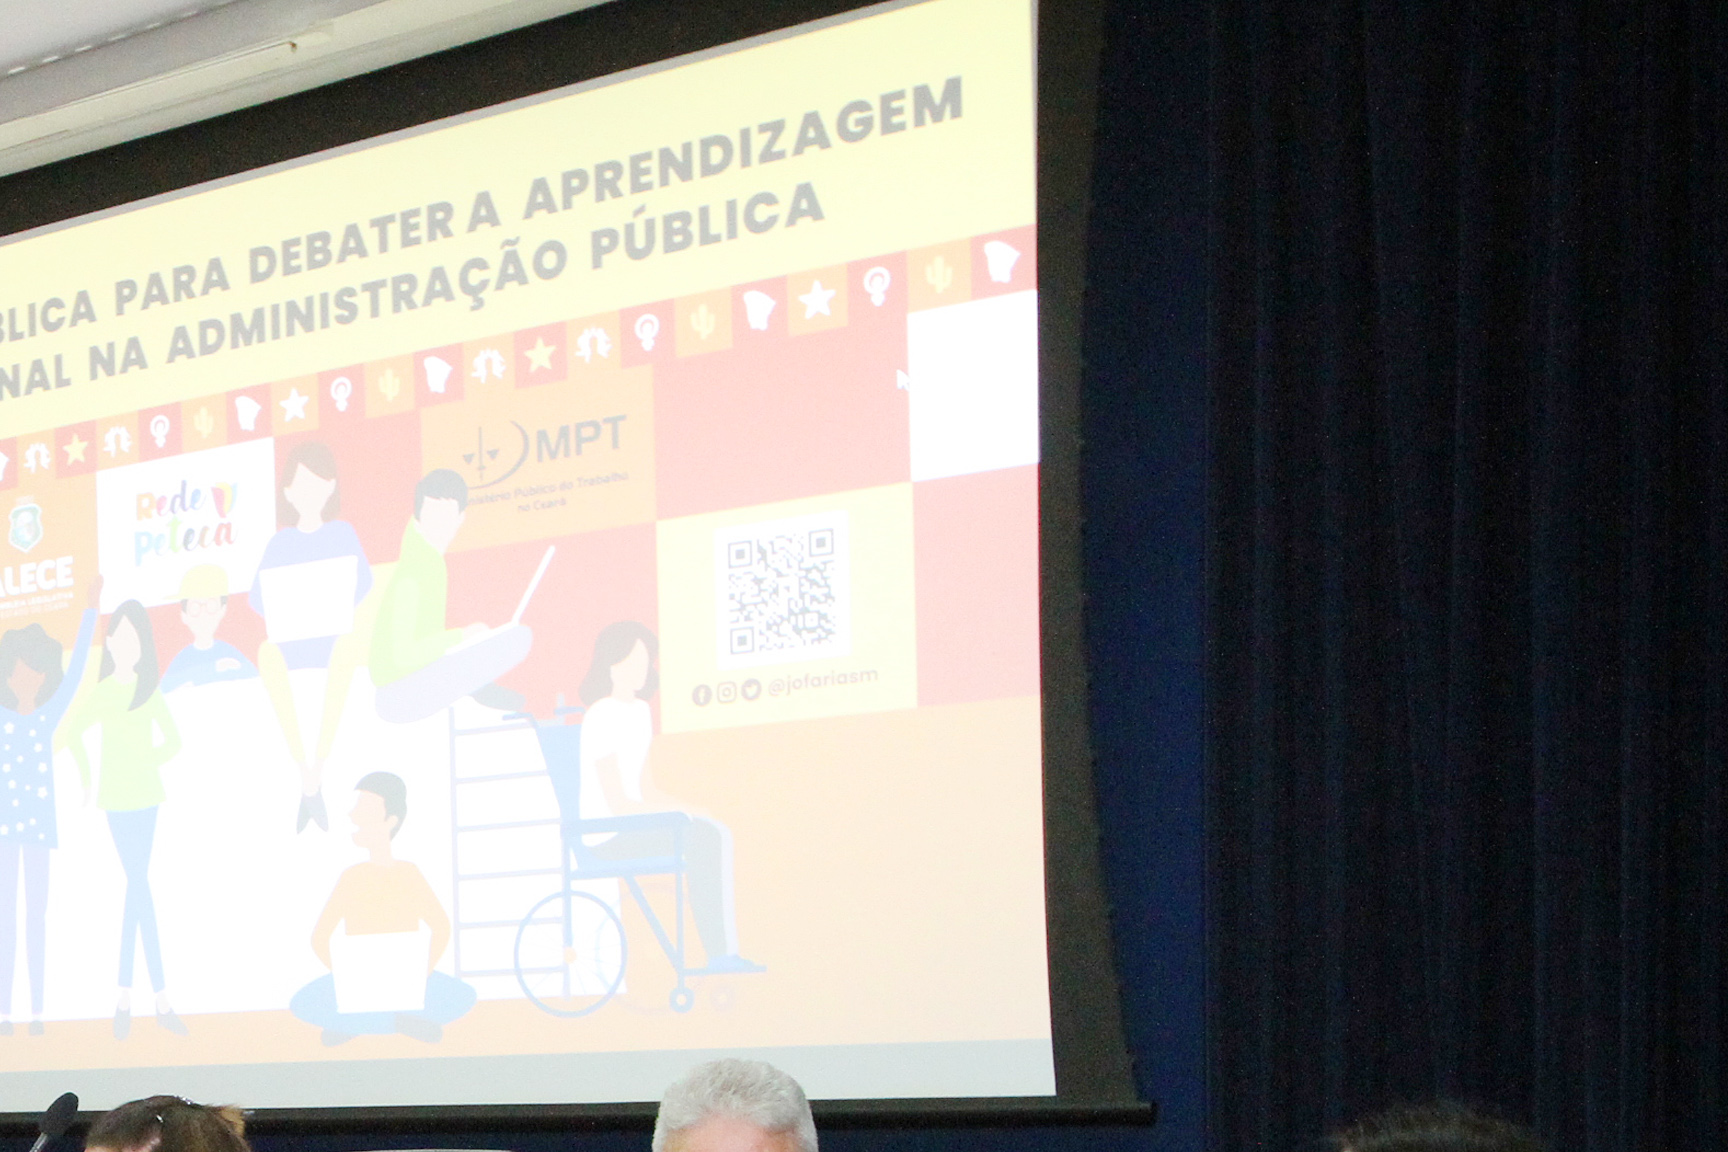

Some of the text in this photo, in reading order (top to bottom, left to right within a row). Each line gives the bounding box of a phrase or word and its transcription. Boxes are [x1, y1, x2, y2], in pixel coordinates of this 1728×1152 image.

[115, 258, 230, 316] PARA
[248, 201, 454, 285] DEBATER
[466, 190, 501, 235] A
[522, 76, 964, 220] APRENDIZAGEM
[89, 336, 148, 382] NA
[166, 236, 567, 364] ADMINISTRAÇÃO
[591, 181, 825, 270] PÚBLICA
[536, 414, 628, 463] MPT
[135, 479, 207, 521] Rede
[768, 669, 879, 697] @jofariasm
